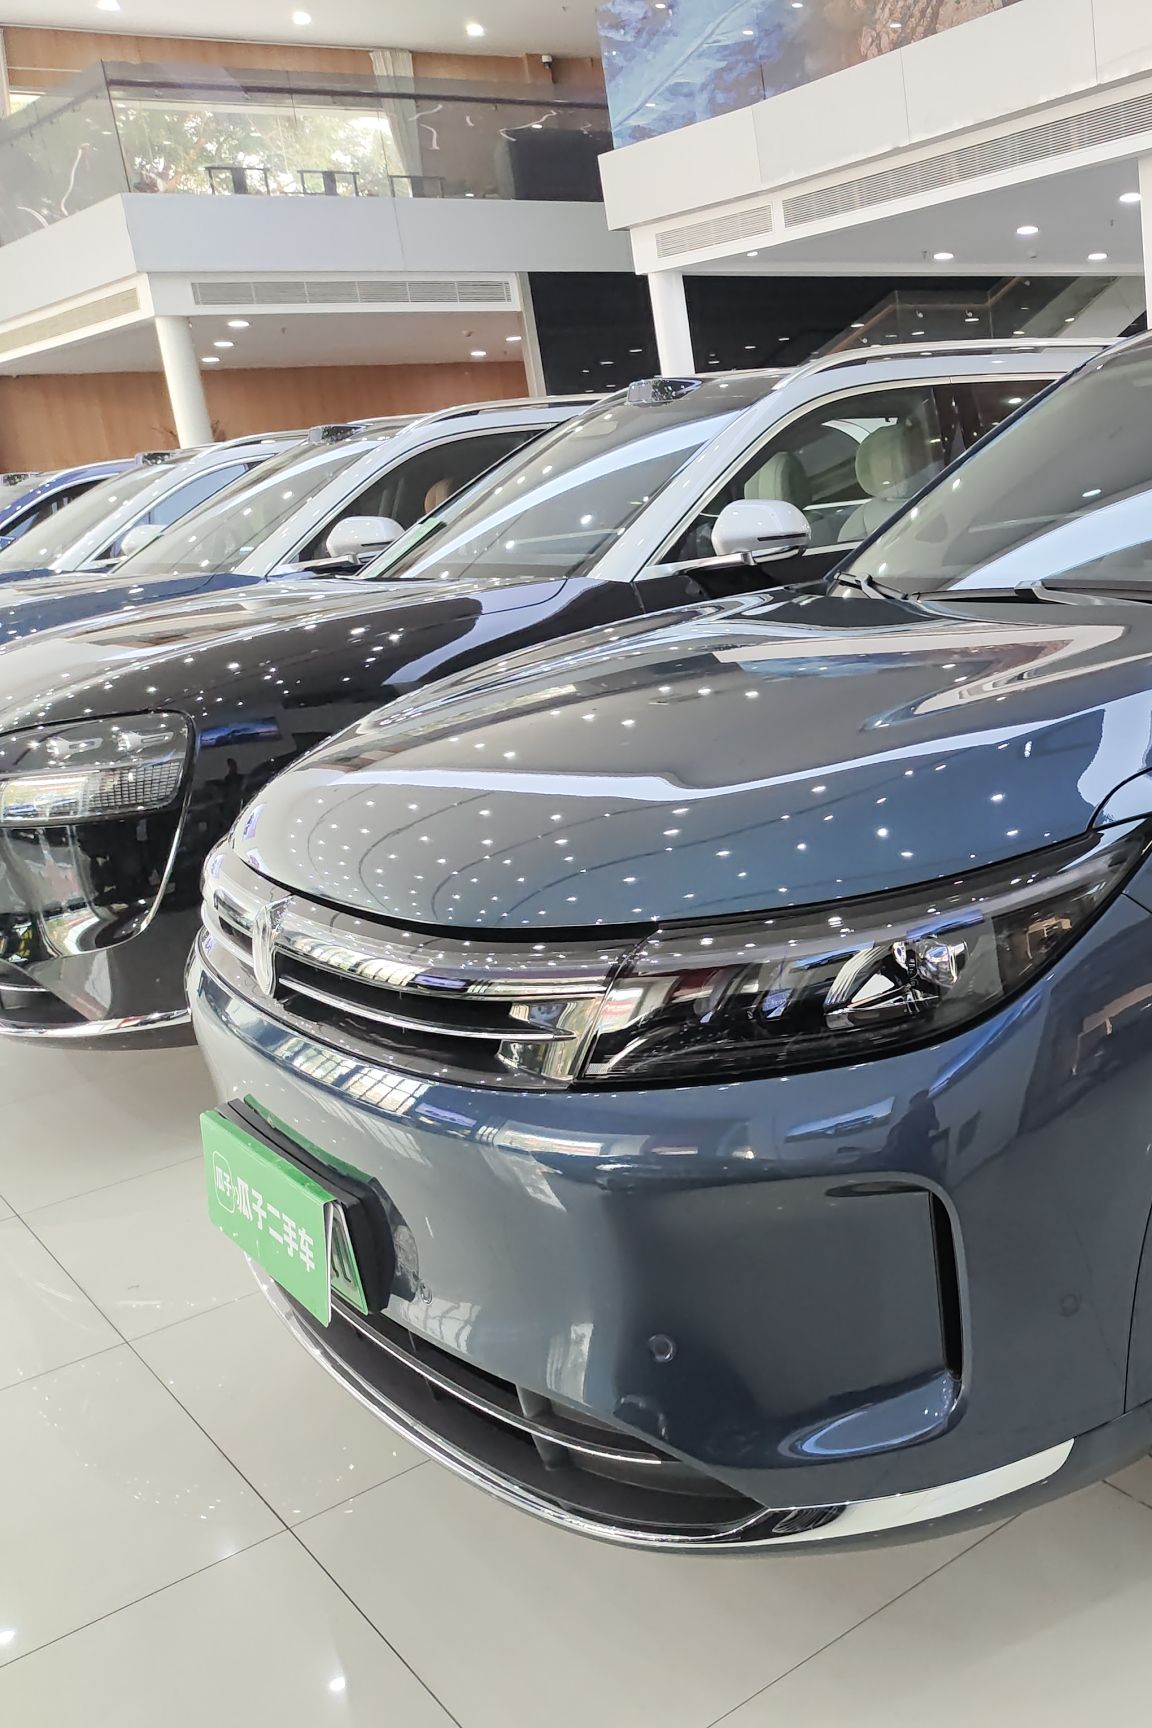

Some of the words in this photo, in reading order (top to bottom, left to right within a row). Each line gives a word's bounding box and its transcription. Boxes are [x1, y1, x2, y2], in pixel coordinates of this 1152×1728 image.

[215, 1166, 232, 1197] 瓜子
[234, 1176, 316, 1273] 瓜子二手车
